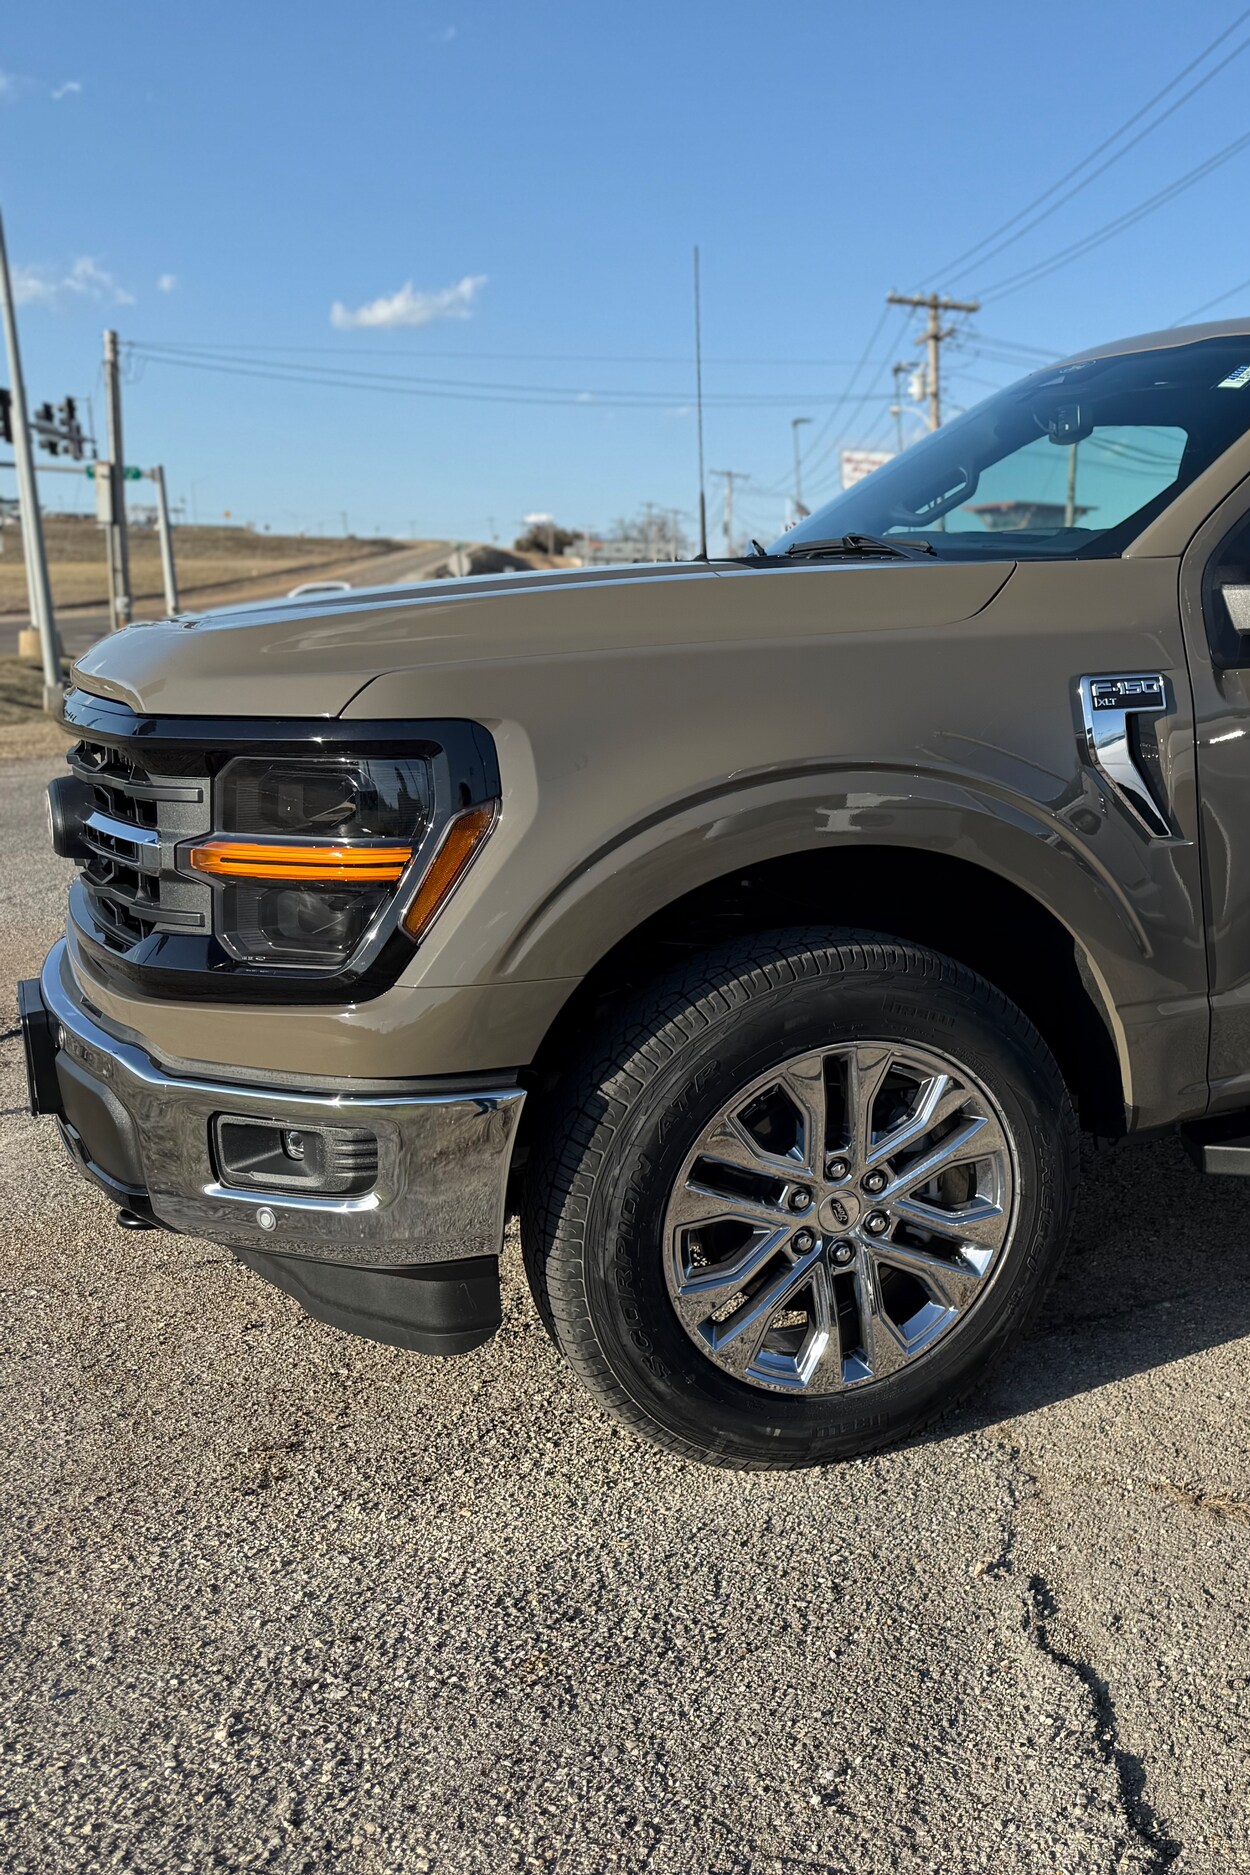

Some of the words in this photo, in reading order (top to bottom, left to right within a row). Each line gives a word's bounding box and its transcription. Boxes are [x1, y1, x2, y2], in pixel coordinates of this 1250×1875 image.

[1092, 680, 1160, 697] F-150
[1097, 698, 1117, 706] XLT
[614, 1153, 671, 1379] SCORPION
[658, 1059, 720, 1145] ATR
[832, 1201, 848, 1223] Ford
